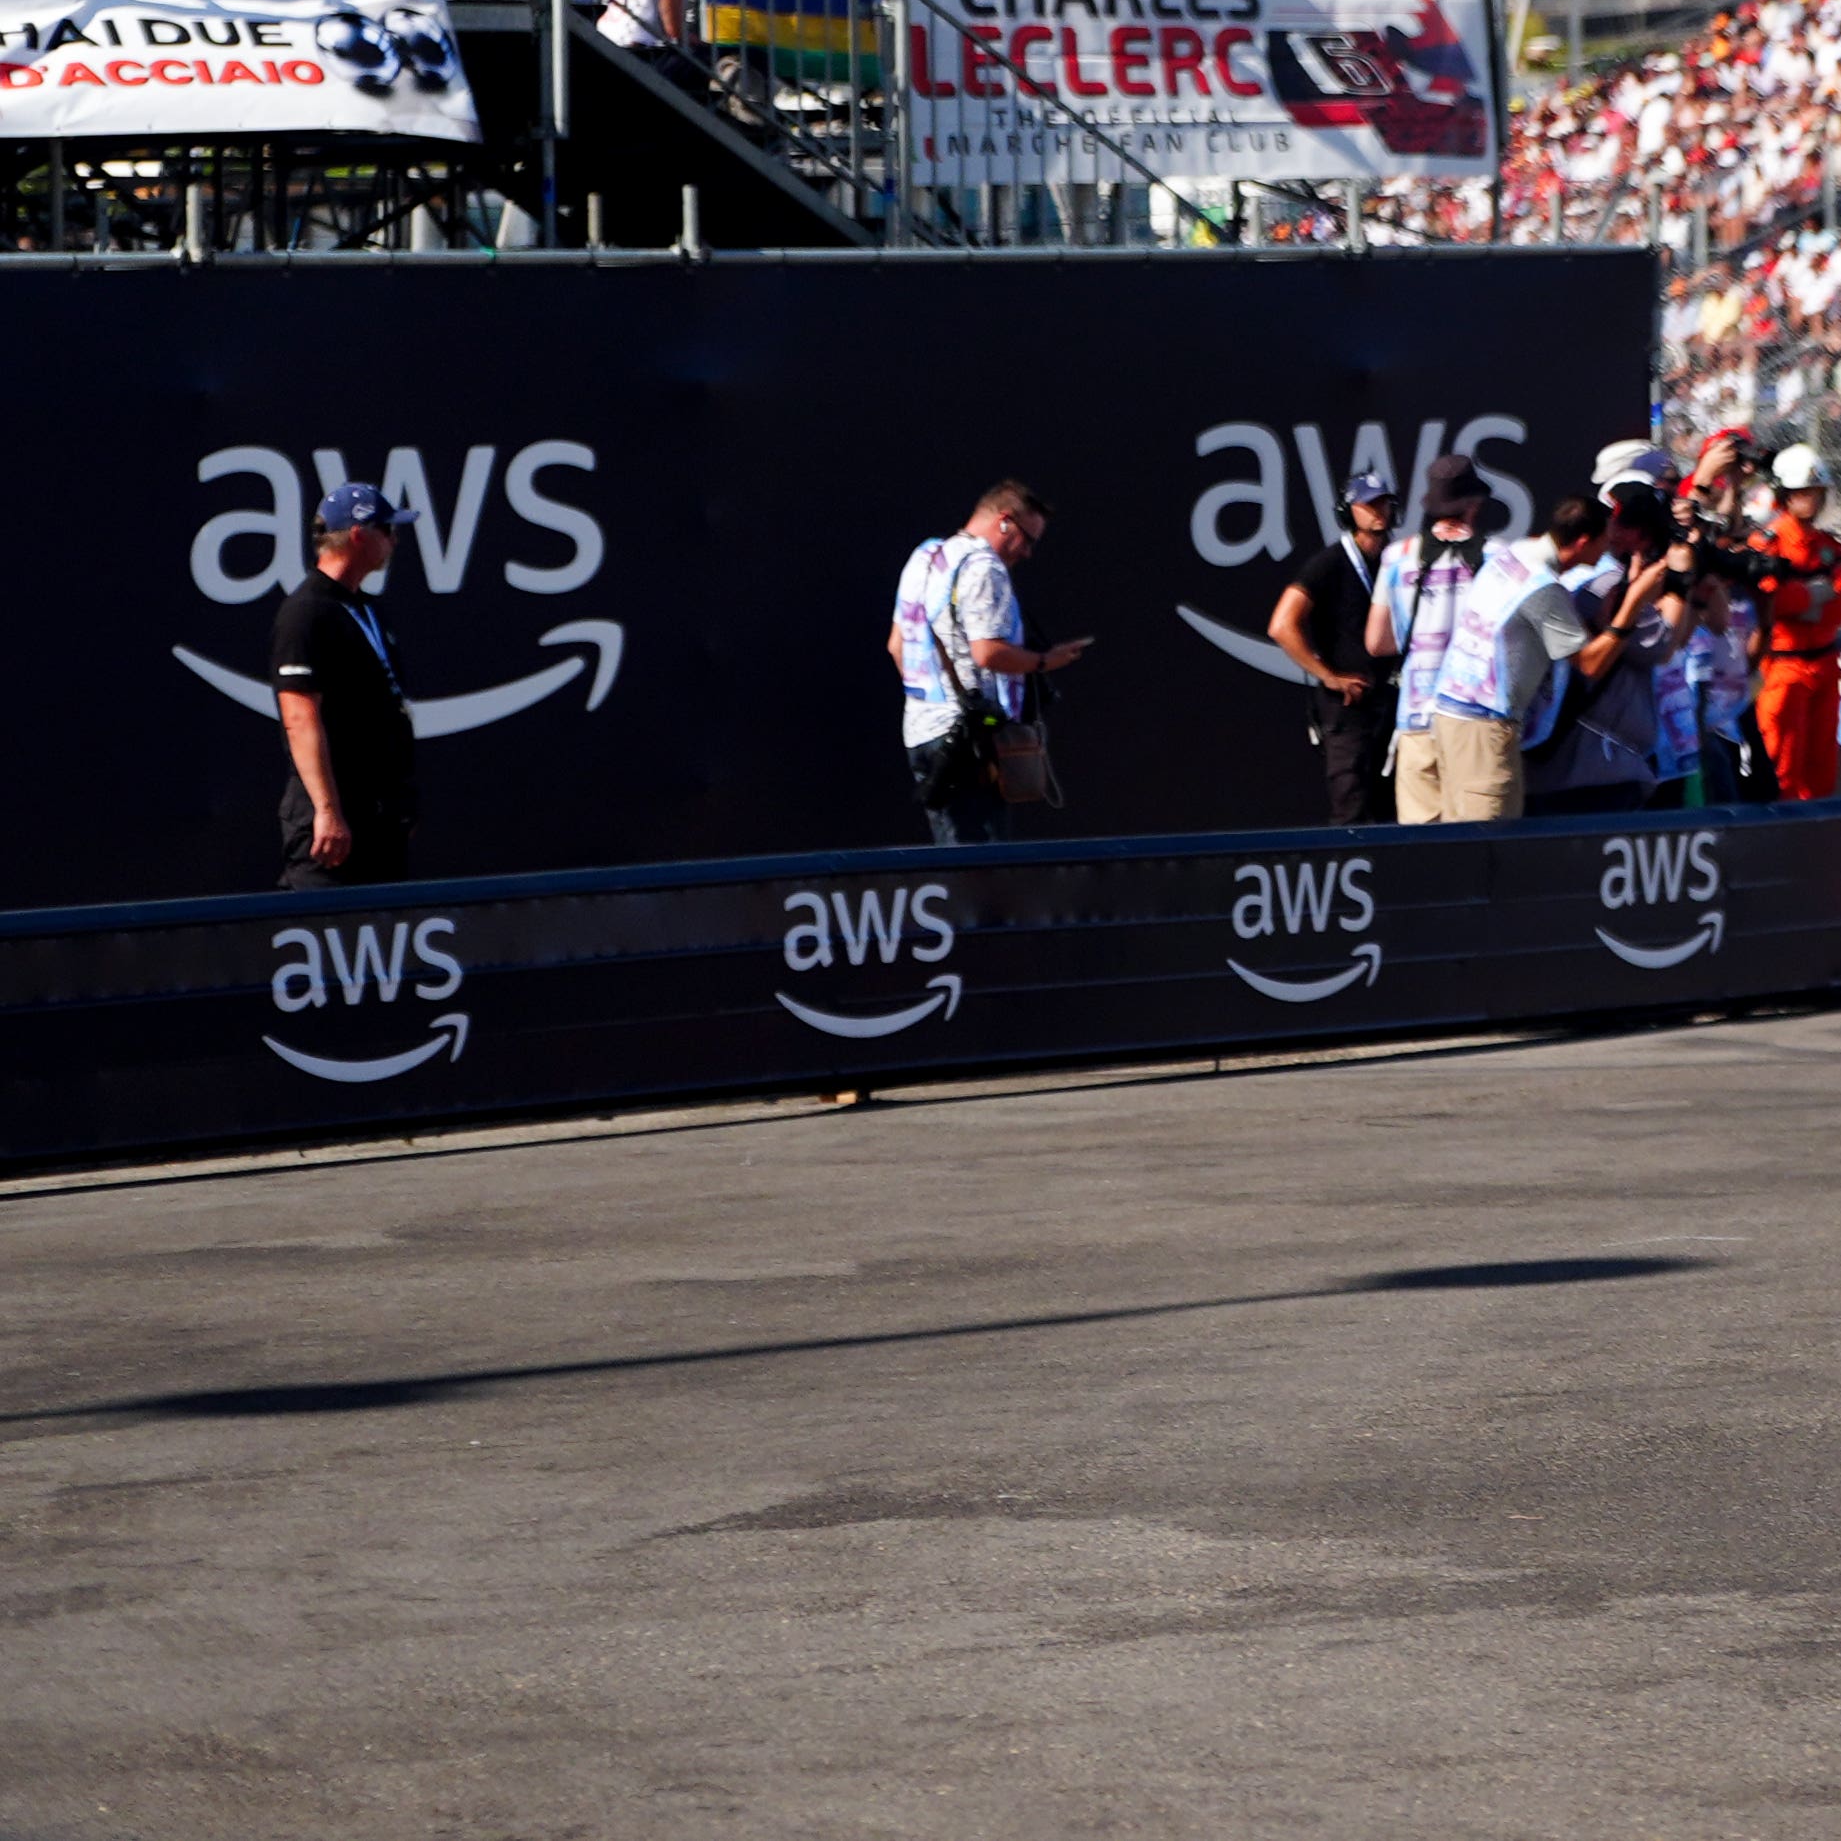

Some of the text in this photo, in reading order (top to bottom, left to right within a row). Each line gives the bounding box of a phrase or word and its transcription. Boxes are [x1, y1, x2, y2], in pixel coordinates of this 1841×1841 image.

[138, 18, 293, 47] DUE
[909, 22, 1264, 99] LECLERC
[0, 59, 326, 90] D'ACCIAIO
[991, 108, 1067, 128] THE
[1119, 132, 1185, 155] FAN
[1206, 130, 1292, 155] CLUB
[190, 439, 605, 605] aws
[1190, 413, 1533, 566] aws
[1232, 857, 1375, 939] aws
[1599, 830, 1719, 910] aws
[271, 916, 463, 1013] aws
[783, 883, 954, 971] aws
